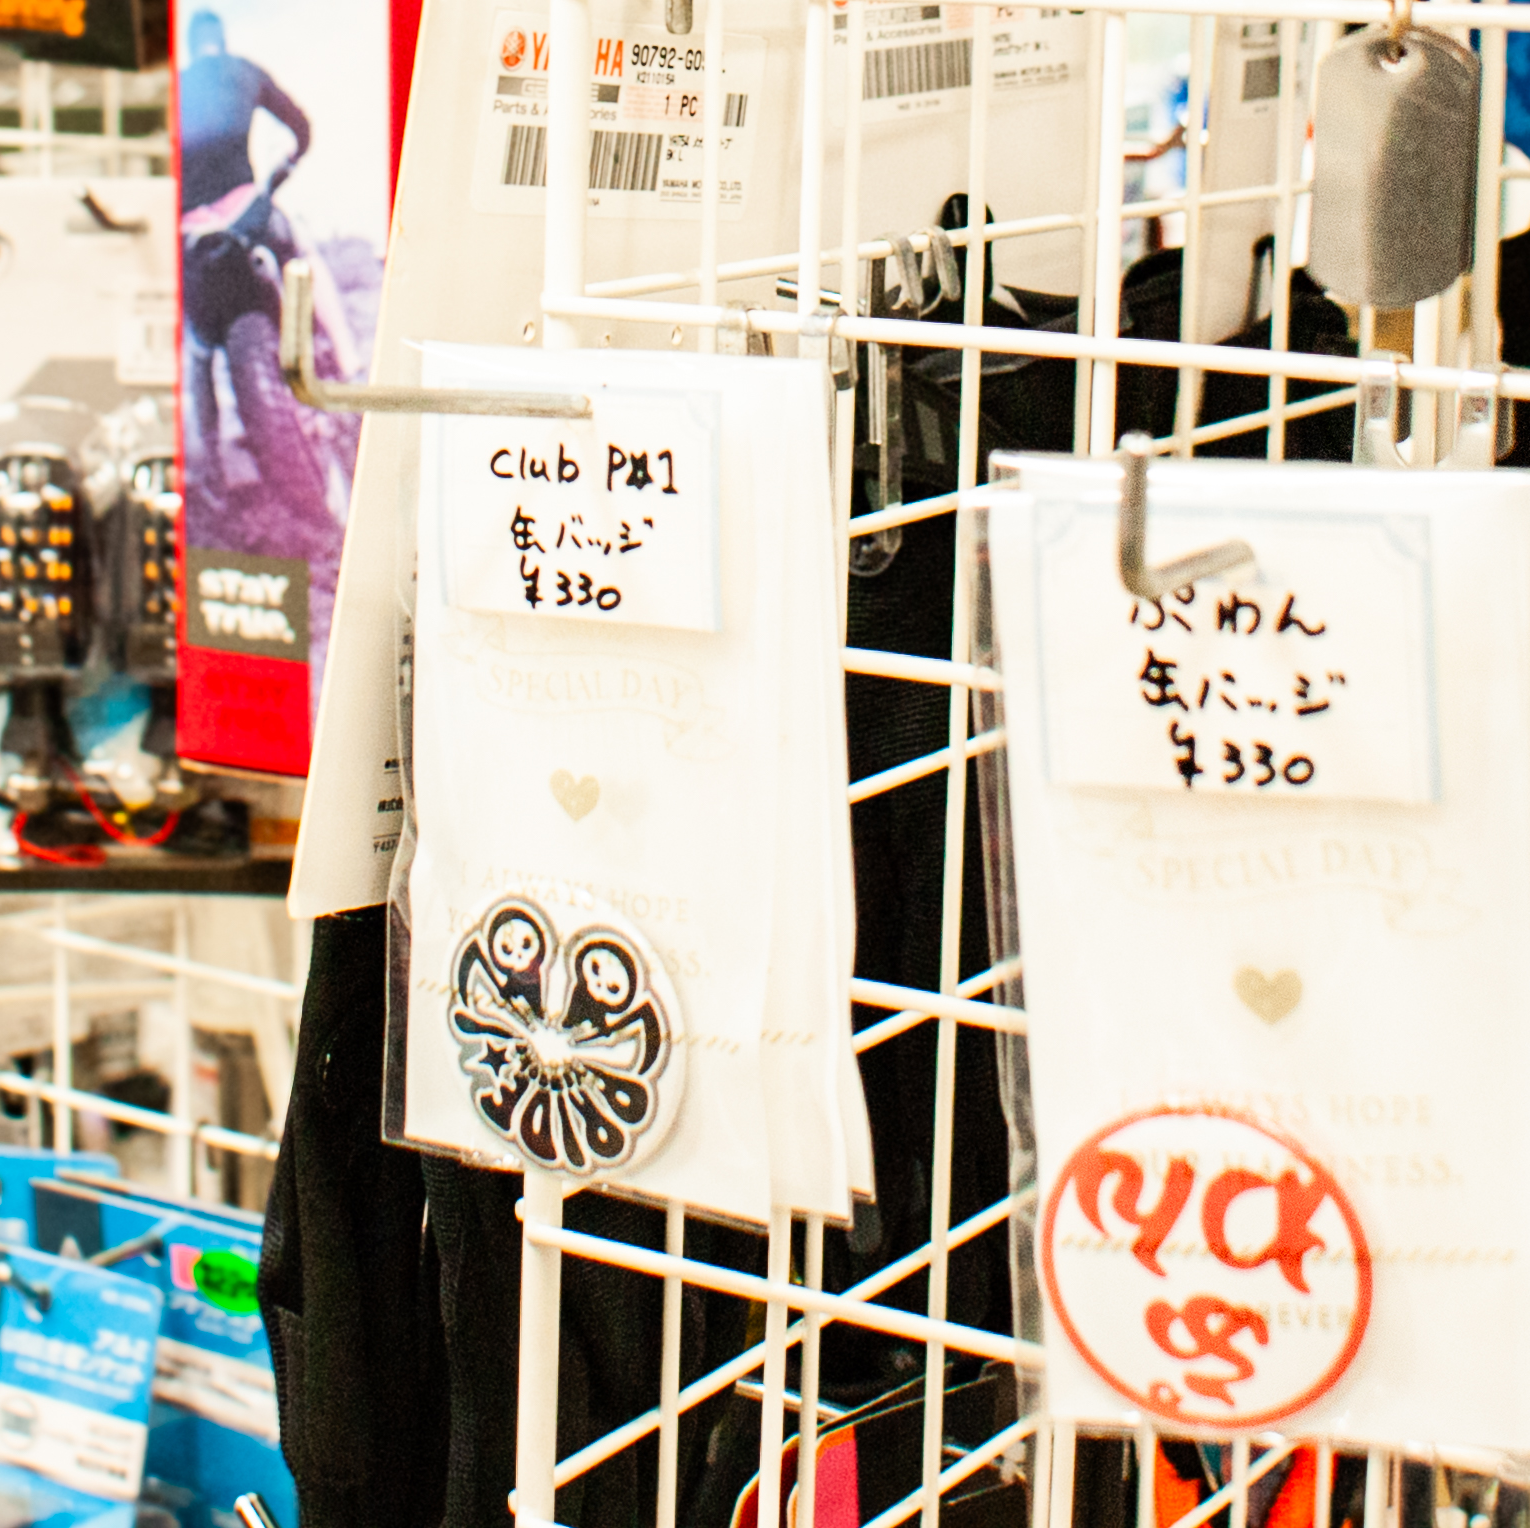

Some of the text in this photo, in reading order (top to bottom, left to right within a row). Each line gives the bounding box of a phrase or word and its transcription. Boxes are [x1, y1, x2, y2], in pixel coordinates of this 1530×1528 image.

[493, 98, 527, 116] Parts
[679, 95, 699, 118] PC
[489, 443, 581, 483] Club
[519, 555, 622, 611] ¥330
[488, 664, 611, 702] SPECIAL
[1169, 719, 1316, 790] ¥330
